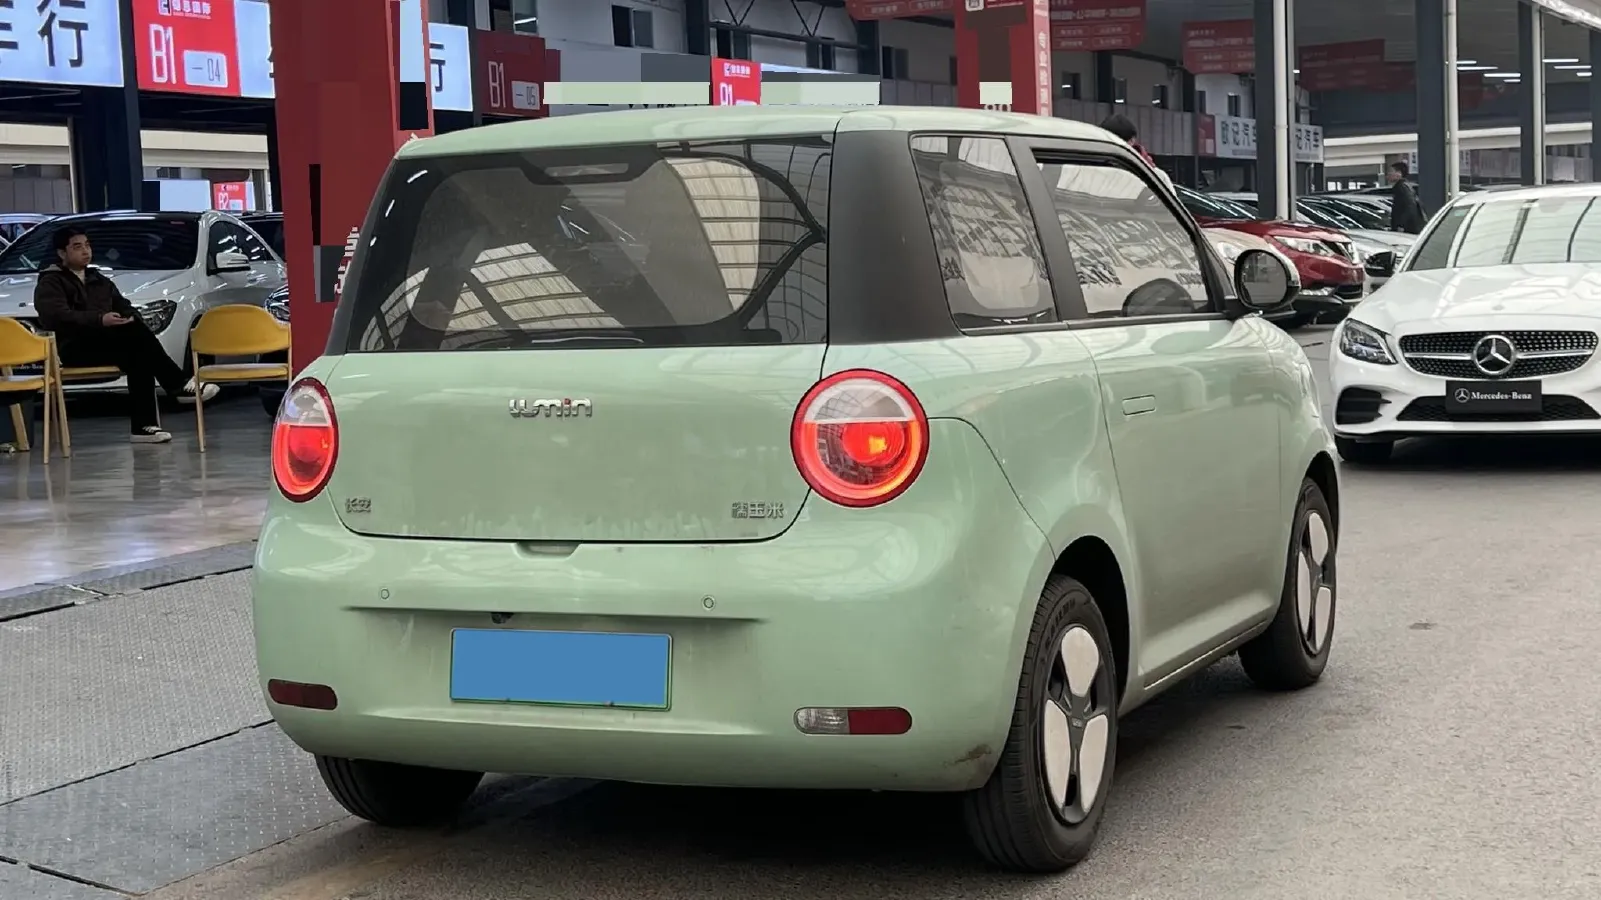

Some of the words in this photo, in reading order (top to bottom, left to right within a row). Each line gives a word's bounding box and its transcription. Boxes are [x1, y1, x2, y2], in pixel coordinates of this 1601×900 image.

[149, 24, 177, 84] B1
[488, 61, 506, 108] B1
[1471, 391, 1532, 400] Mercedes-Benz
[732, 501, 784, 519] 糯玉米
